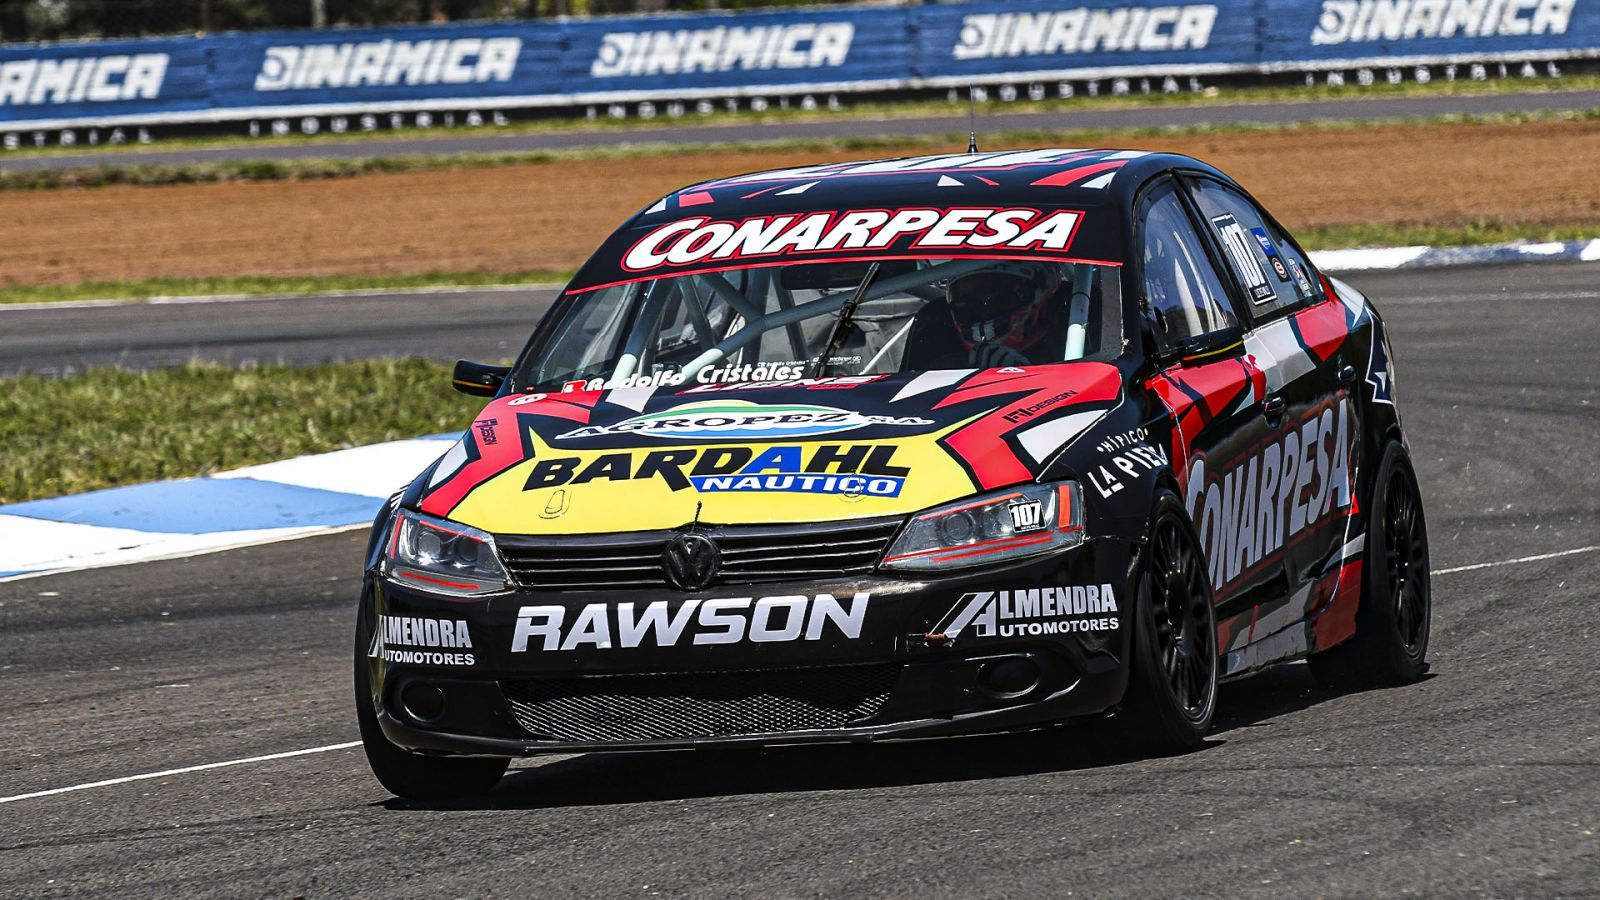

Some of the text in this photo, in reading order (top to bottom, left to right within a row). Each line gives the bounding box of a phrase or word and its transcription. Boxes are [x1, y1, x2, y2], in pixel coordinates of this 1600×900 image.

[623, 208, 1081, 270] CONARPESA
[1219, 223, 1265, 288] 107
[697, 362, 804, 383] Cristales
[558, 412, 853, 439] AGROPEZ
[522, 446, 911, 492] BARDAHL
[701, 475, 898, 494] NAUTICO
[1088, 466, 1124, 498] LA
[1011, 503, 1040, 527] 107
[511, 593, 871, 652] RAWSON
